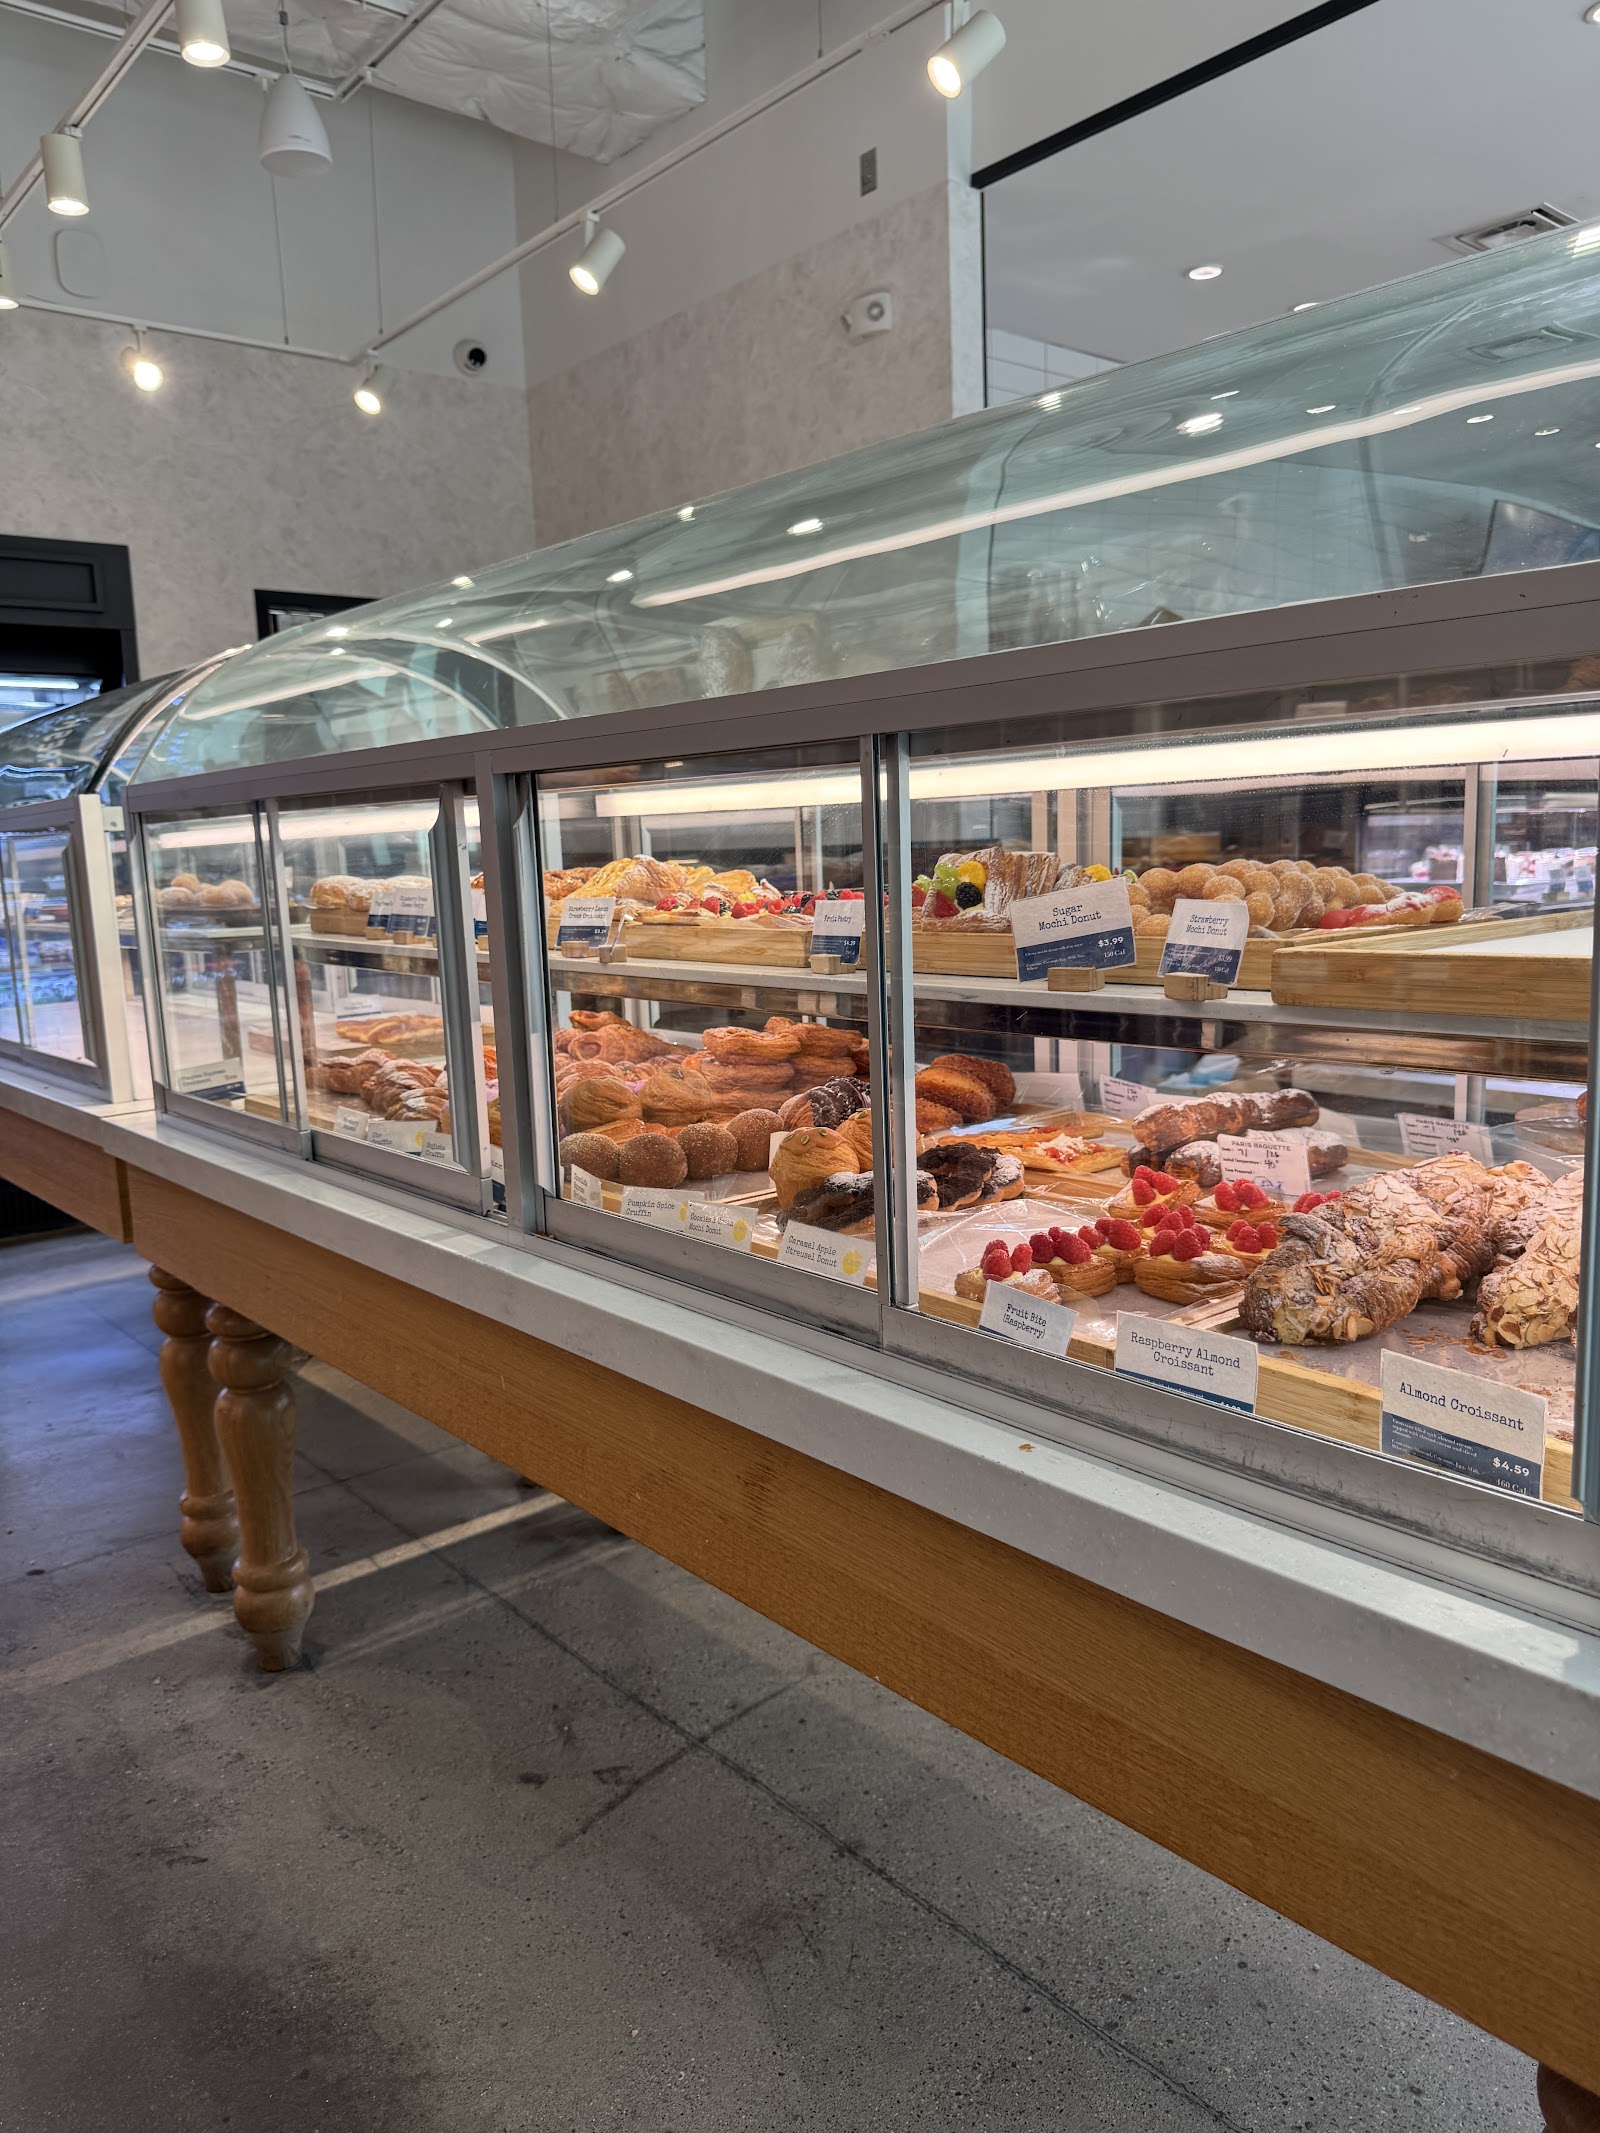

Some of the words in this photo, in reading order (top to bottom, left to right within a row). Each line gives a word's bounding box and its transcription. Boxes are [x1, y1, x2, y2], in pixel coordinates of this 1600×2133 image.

[1052, 905, 1083, 917] Sugar
[1038, 917, 1069, 931] Mochi
[1071, 911, 1102, 924] Donut
[1190, 914, 1229, 927] Strawberry
[1185, 924, 1205, 934] Mochi
[1206, 926, 1228, 936] Donut
[1098, 936, 1124, 948] $3.99
[1104, 950, 1114, 958] 150
[1114, 948, 1126, 956] Cal
[1231, 1140, 1252, 1148] PARIS
[1253, 1142, 1292, 1152] BAGUETTE
[627, 1198, 655, 1209] Pumpkin
[656, 1200, 675, 1210] Spice
[625, 1208, 652, 1217] Cruffin
[705, 1225, 722, 1235] Donut
[788, 1235, 815, 1250] Caramel
[816, 1243, 837, 1256] Apple
[785, 1245, 815, 1261] Streusel
[816, 1254, 837, 1268] Donut
[1006, 1303, 1029, 1320] Fruit
[1030, 1311, 1047, 1327] Bite
[1002, 1313, 1046, 1339] (Raspberry)
[1131, 1331, 1193, 1359] Raspberry
[1196, 1347, 1241, 1369] Almond
[1153, 1351, 1214, 1376] Croissant
[1399, 1381, 1447, 1407] Almond
[1450, 1398, 1524, 1431] Croissant
[1492, 1456, 1530, 1477] $4.59
